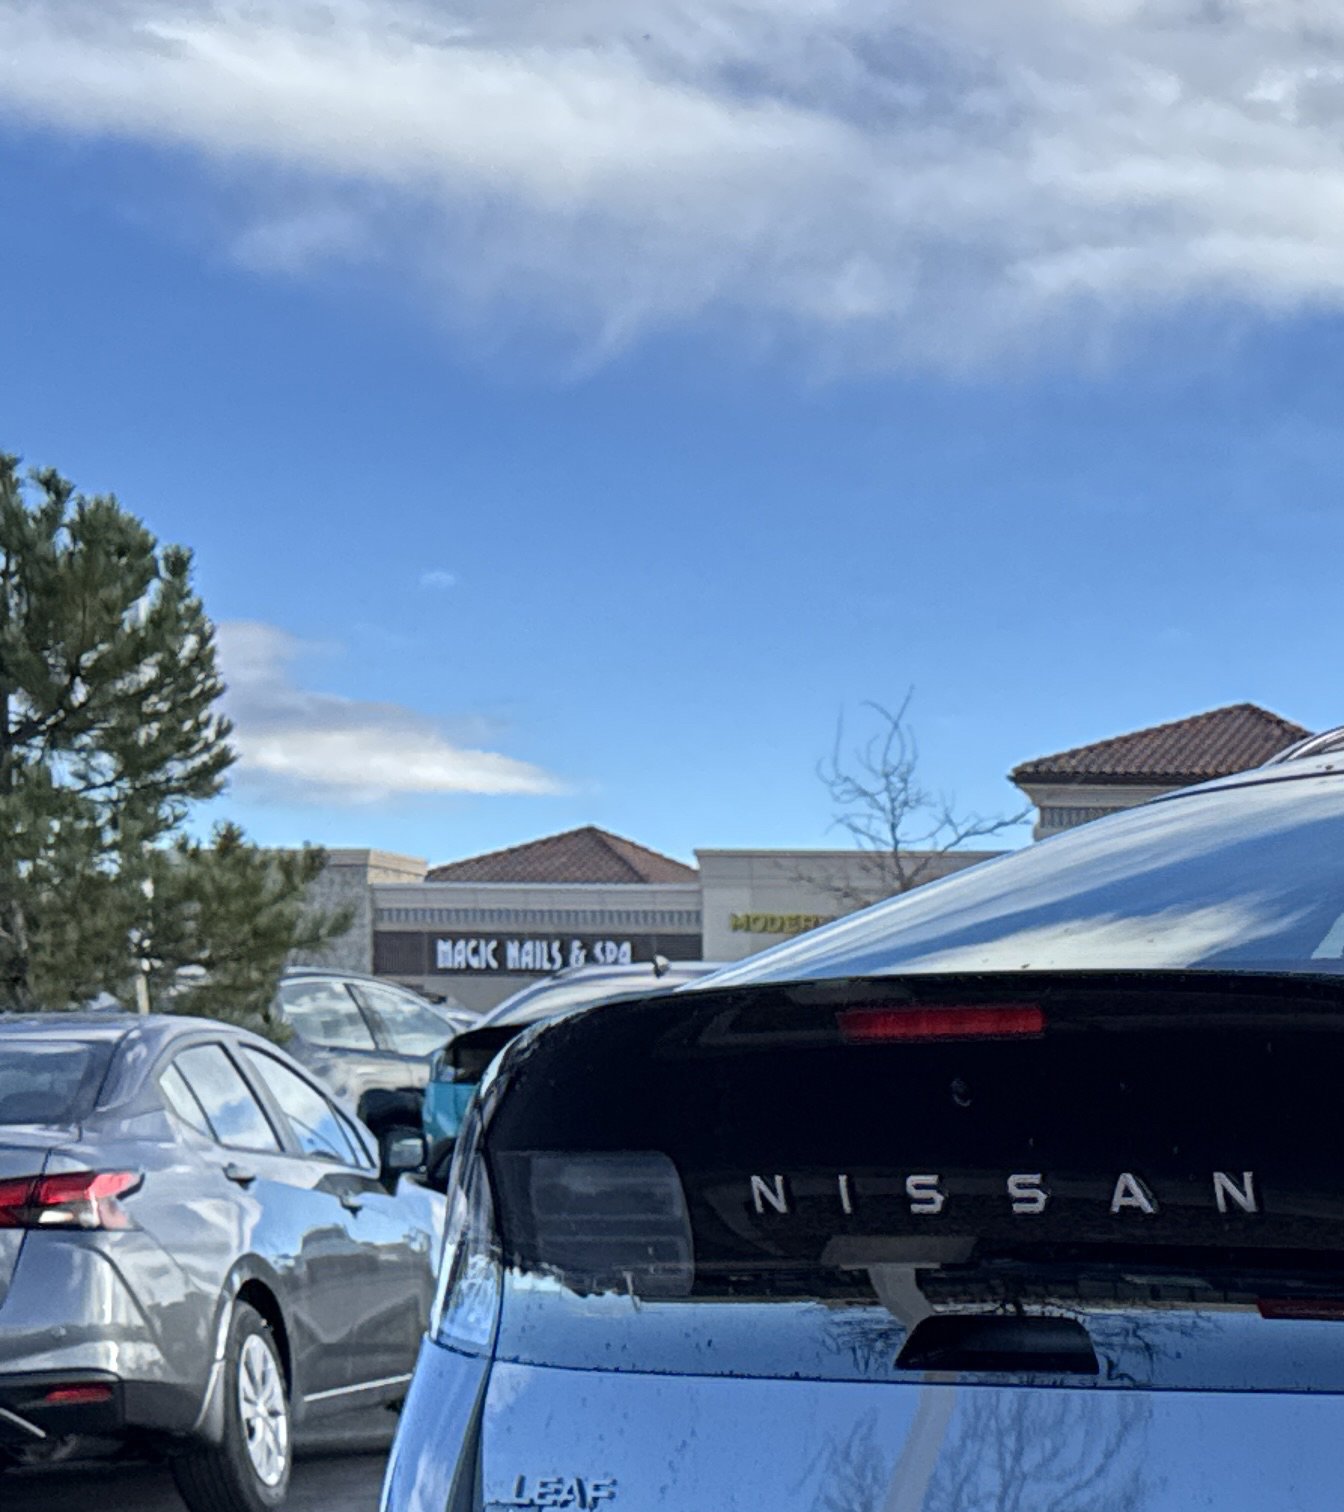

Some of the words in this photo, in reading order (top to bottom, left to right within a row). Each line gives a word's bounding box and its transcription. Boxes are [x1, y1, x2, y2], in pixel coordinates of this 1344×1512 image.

[436, 938, 499, 969] MAGIC
[506, 939, 563, 970] NAILS
[569, 939, 587, 968] &
[593, 940, 632, 965] SPA
[750, 1170, 1259, 1214] NISSAN
[513, 1474, 617, 1511] LEAF
